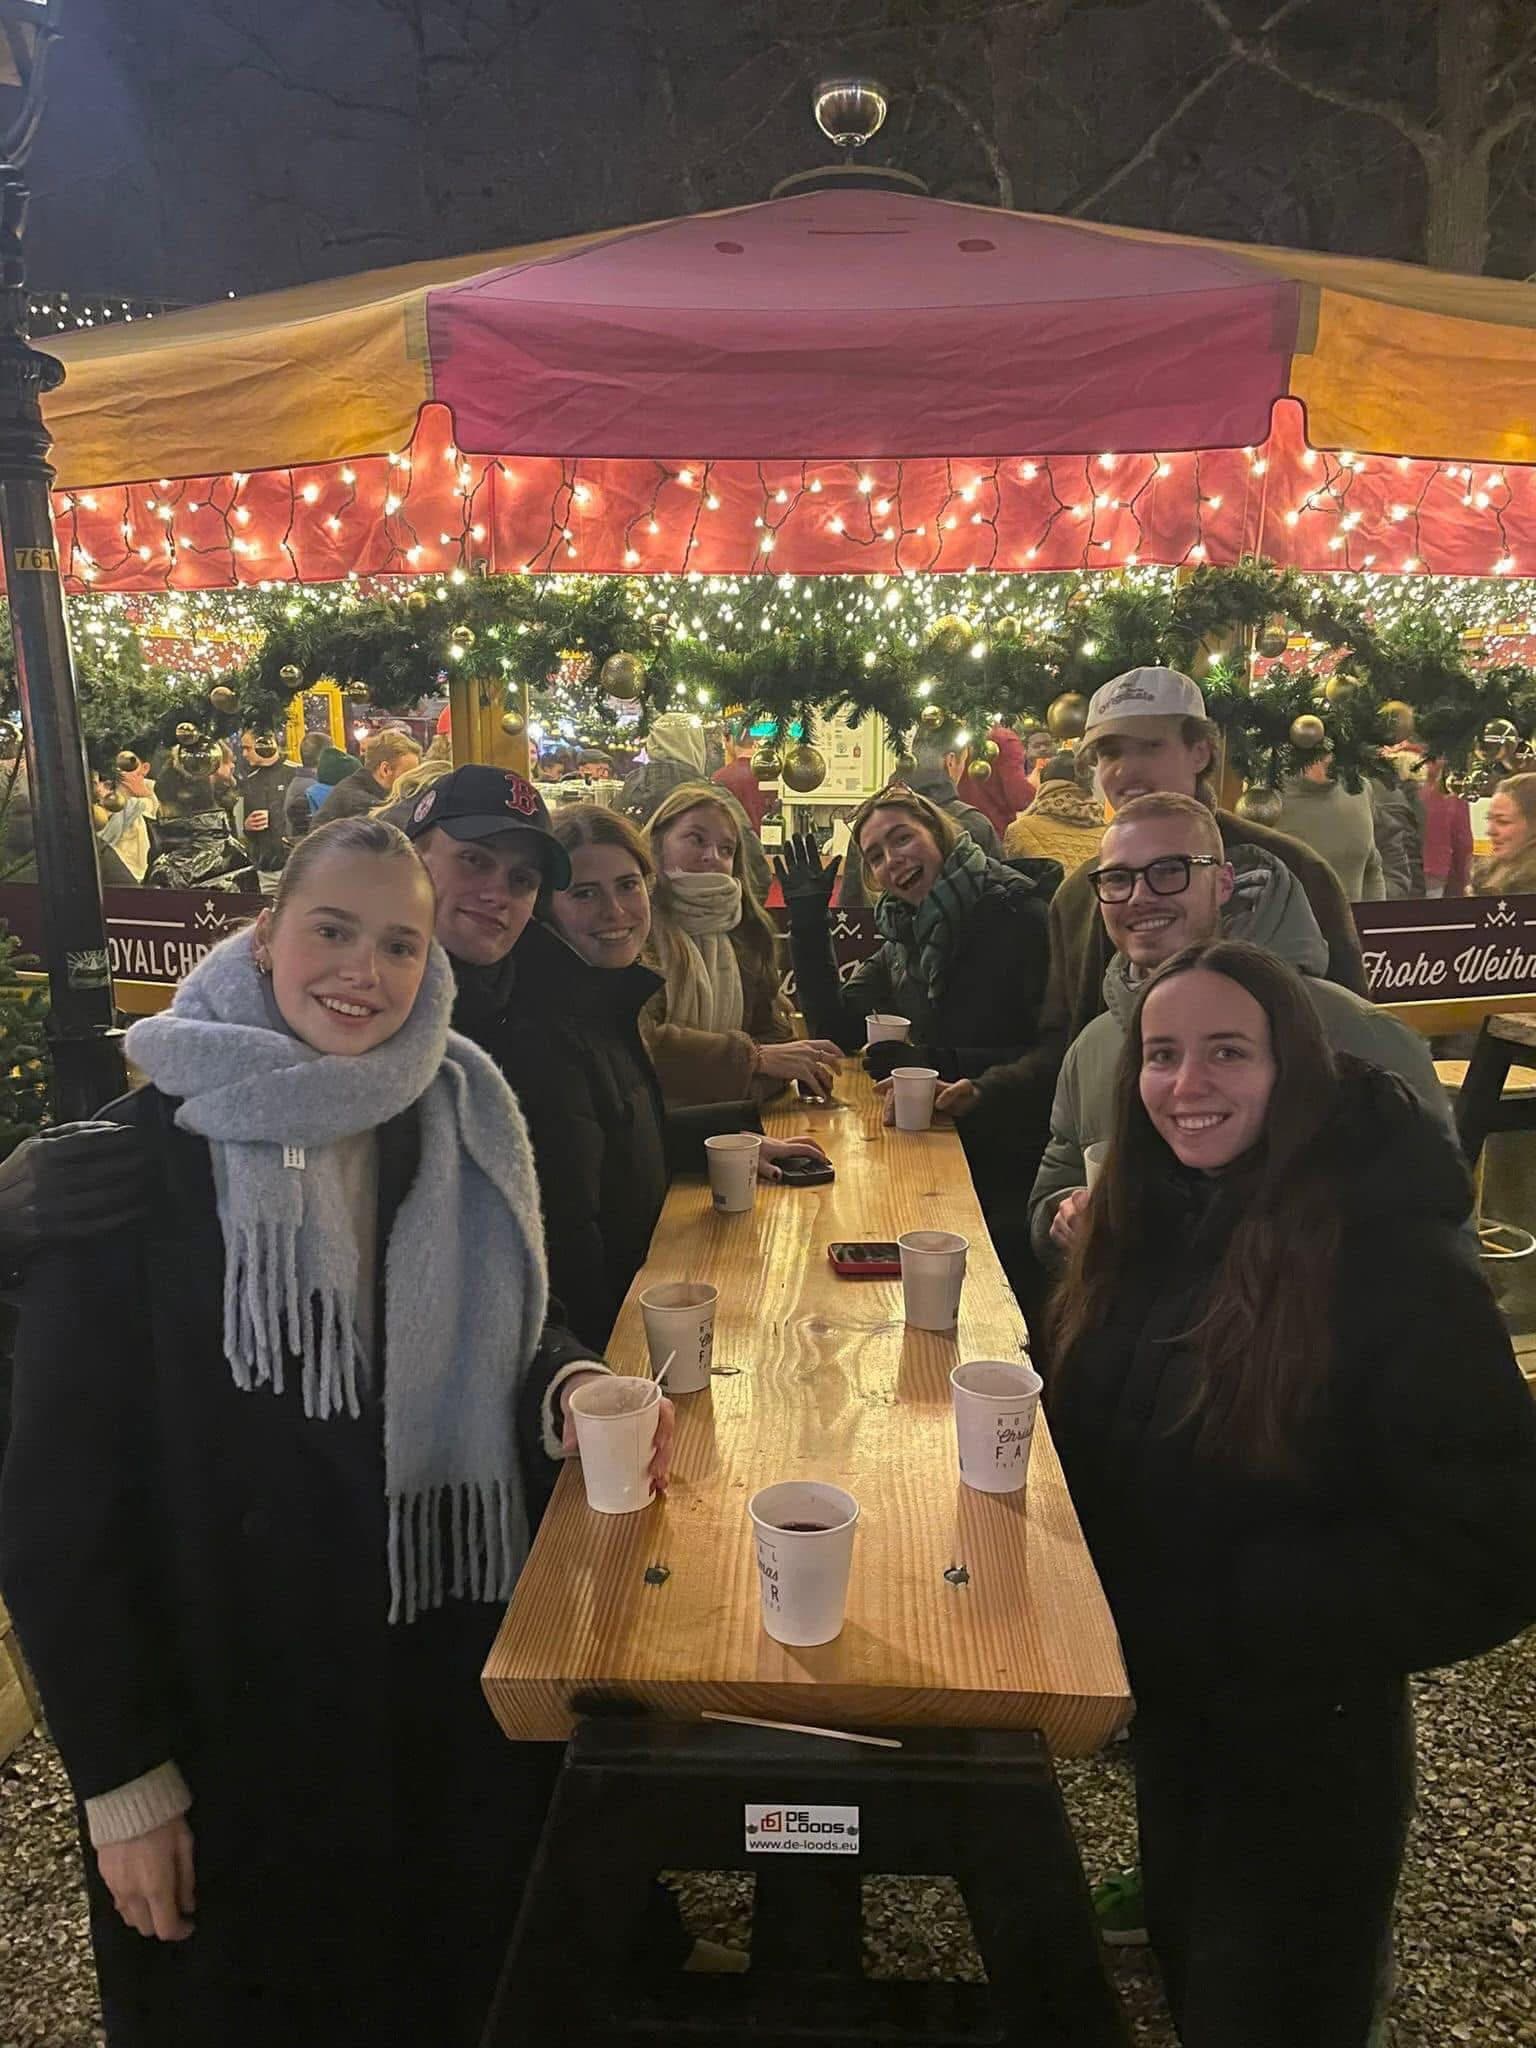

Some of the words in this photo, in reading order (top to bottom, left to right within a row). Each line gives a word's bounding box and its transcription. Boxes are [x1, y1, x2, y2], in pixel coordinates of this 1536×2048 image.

[16, 550, 53, 569] 761
[505, 774, 538, 816] B
[1362, 951, 1448, 988] Frohe
[786, 1811, 809, 1822] DE
[786, 1822, 845, 1834] LOODS
[750, 1840, 857, 1851] www.de-loods.eu
